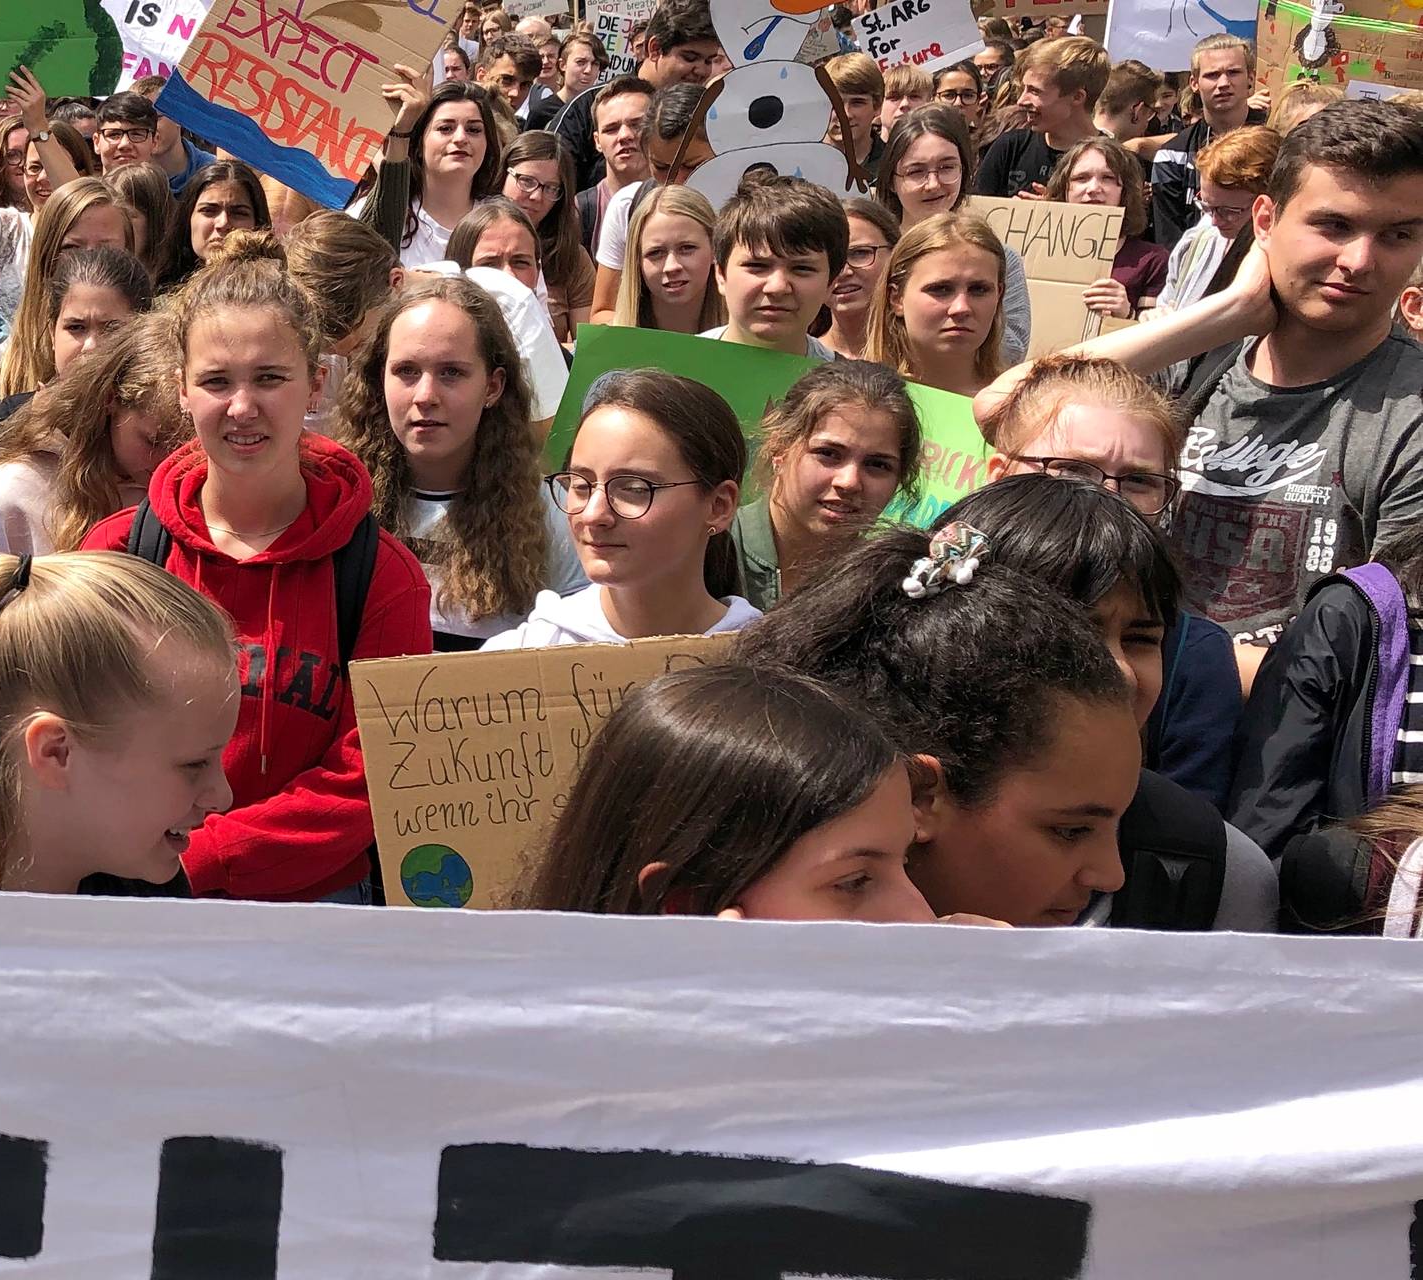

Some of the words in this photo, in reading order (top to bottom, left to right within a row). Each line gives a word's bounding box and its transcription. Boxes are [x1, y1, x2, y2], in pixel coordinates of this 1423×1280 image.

[124, 0, 162, 27] IS
[598, 15, 620, 33] DIE
[217, 0, 380, 94] EXPECT
[867, 36, 901, 59] for
[878, 42, 944, 73] Fture
[184, 31, 382, 182] RESISTANCE
[985, 206, 1122, 262] CHANGE
[366, 666, 547, 738] Warum
[570, 662, 637, 750] für
[389, 730, 555, 799] Zukunft
[393, 799, 480, 838] wenn
[486, 787, 541, 826] ihr
